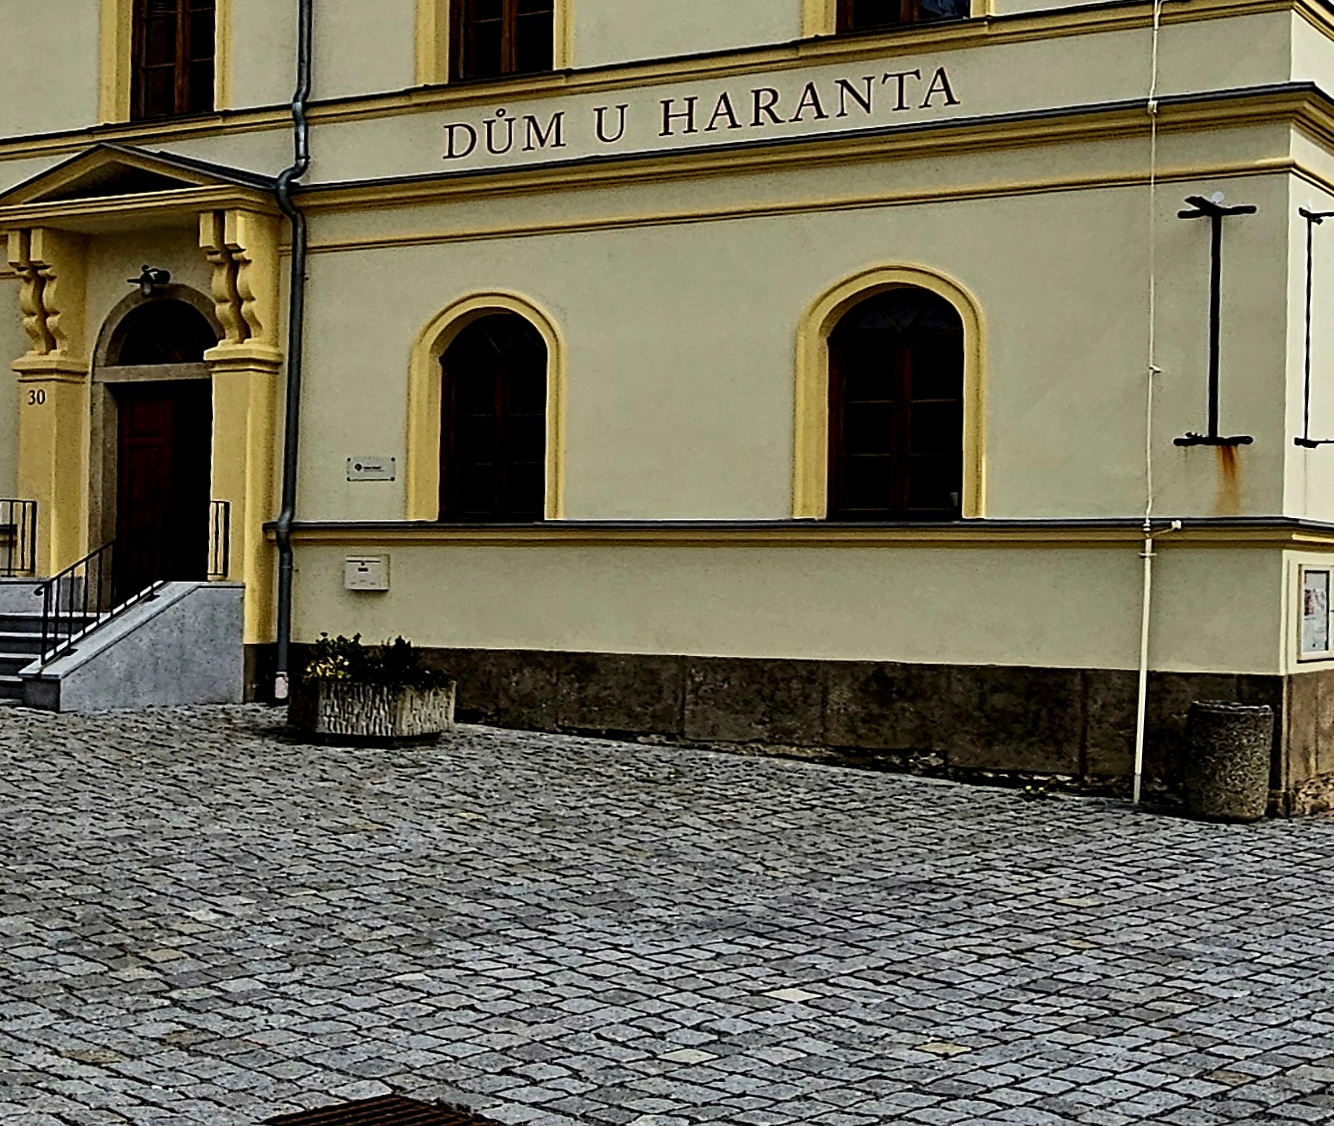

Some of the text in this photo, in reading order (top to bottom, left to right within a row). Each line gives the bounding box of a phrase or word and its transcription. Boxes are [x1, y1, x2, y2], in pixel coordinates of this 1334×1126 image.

[443, 66, 961, 160] DŮM U HARANTA
[27, 389, 46, 406] 30
